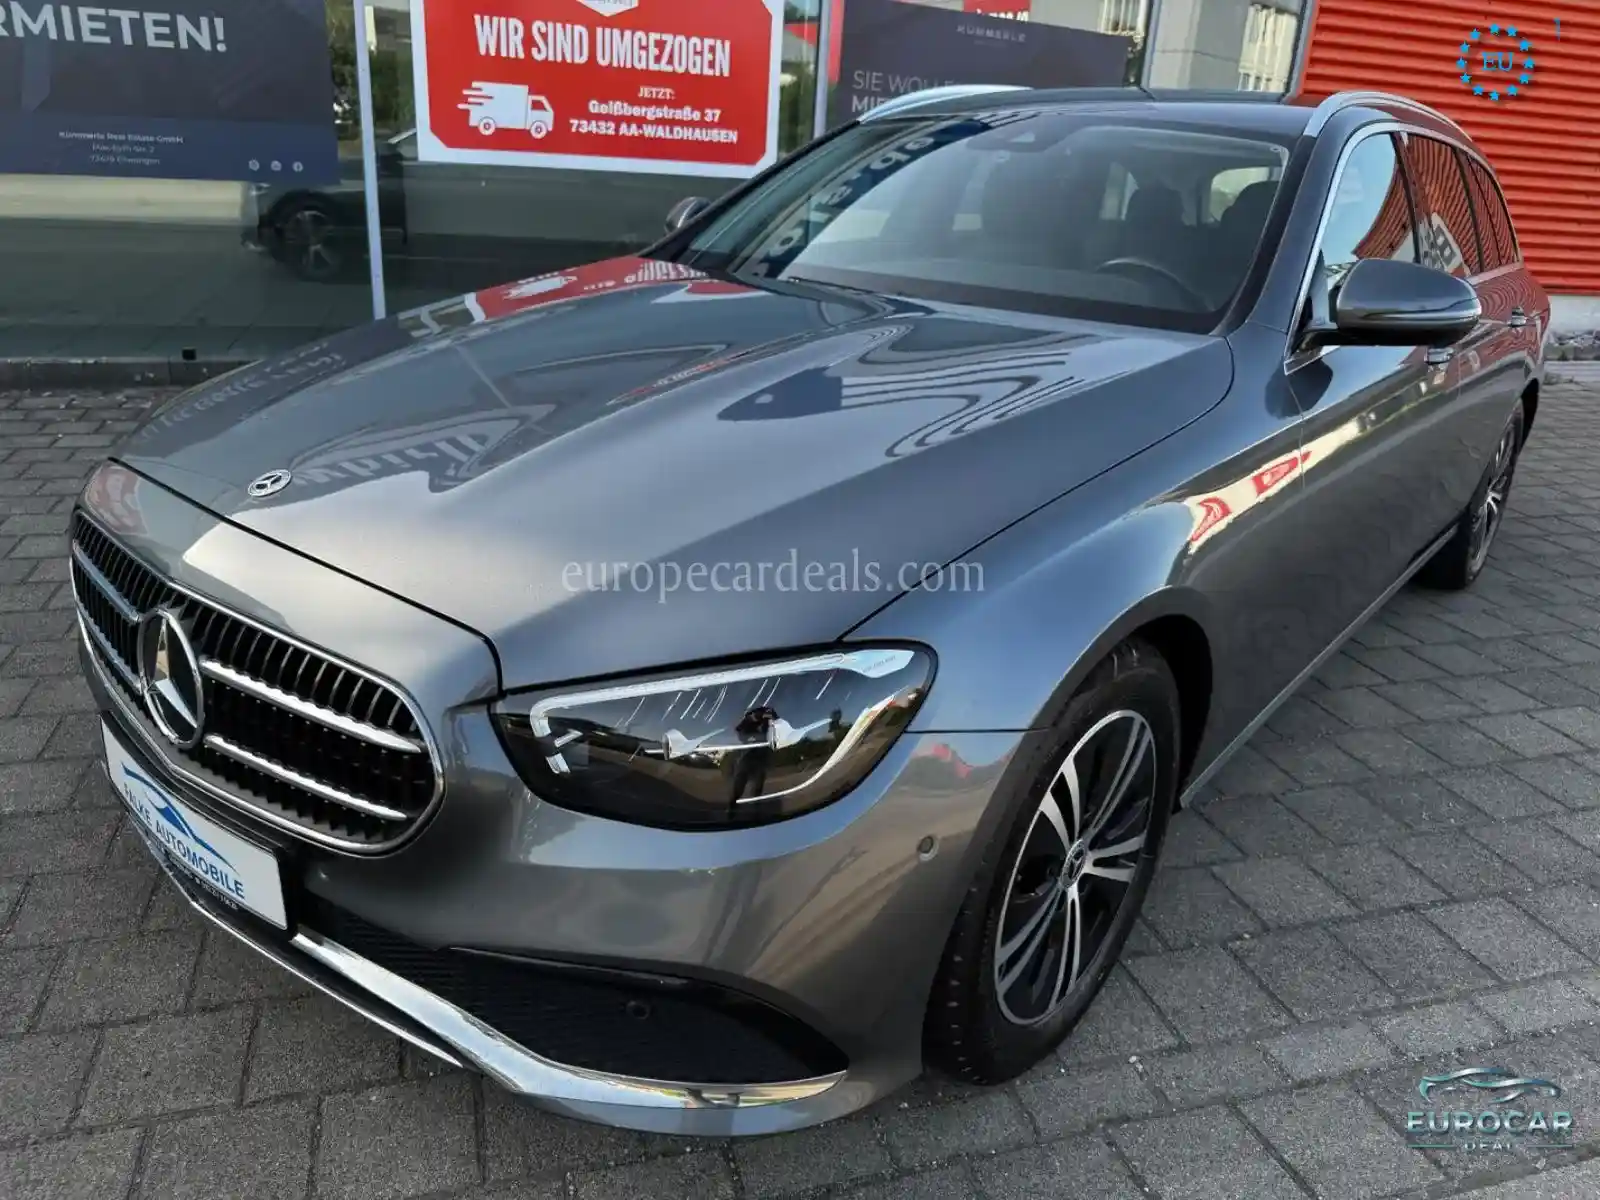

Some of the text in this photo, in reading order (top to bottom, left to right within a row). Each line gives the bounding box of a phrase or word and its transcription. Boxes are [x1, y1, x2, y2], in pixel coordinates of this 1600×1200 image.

[474, 14, 731, 77] WIR SIND UMGEZOGEN
[637, 85, 676, 100] JETZT:
[851, 70, 883, 92] SIE
[588, 100, 722, 123] Geißbergstraße 37
[569, 118, 738, 144] 73432 AA-WALDHAUSEN
[155, 819, 245, 900] AUTOMOBILE
